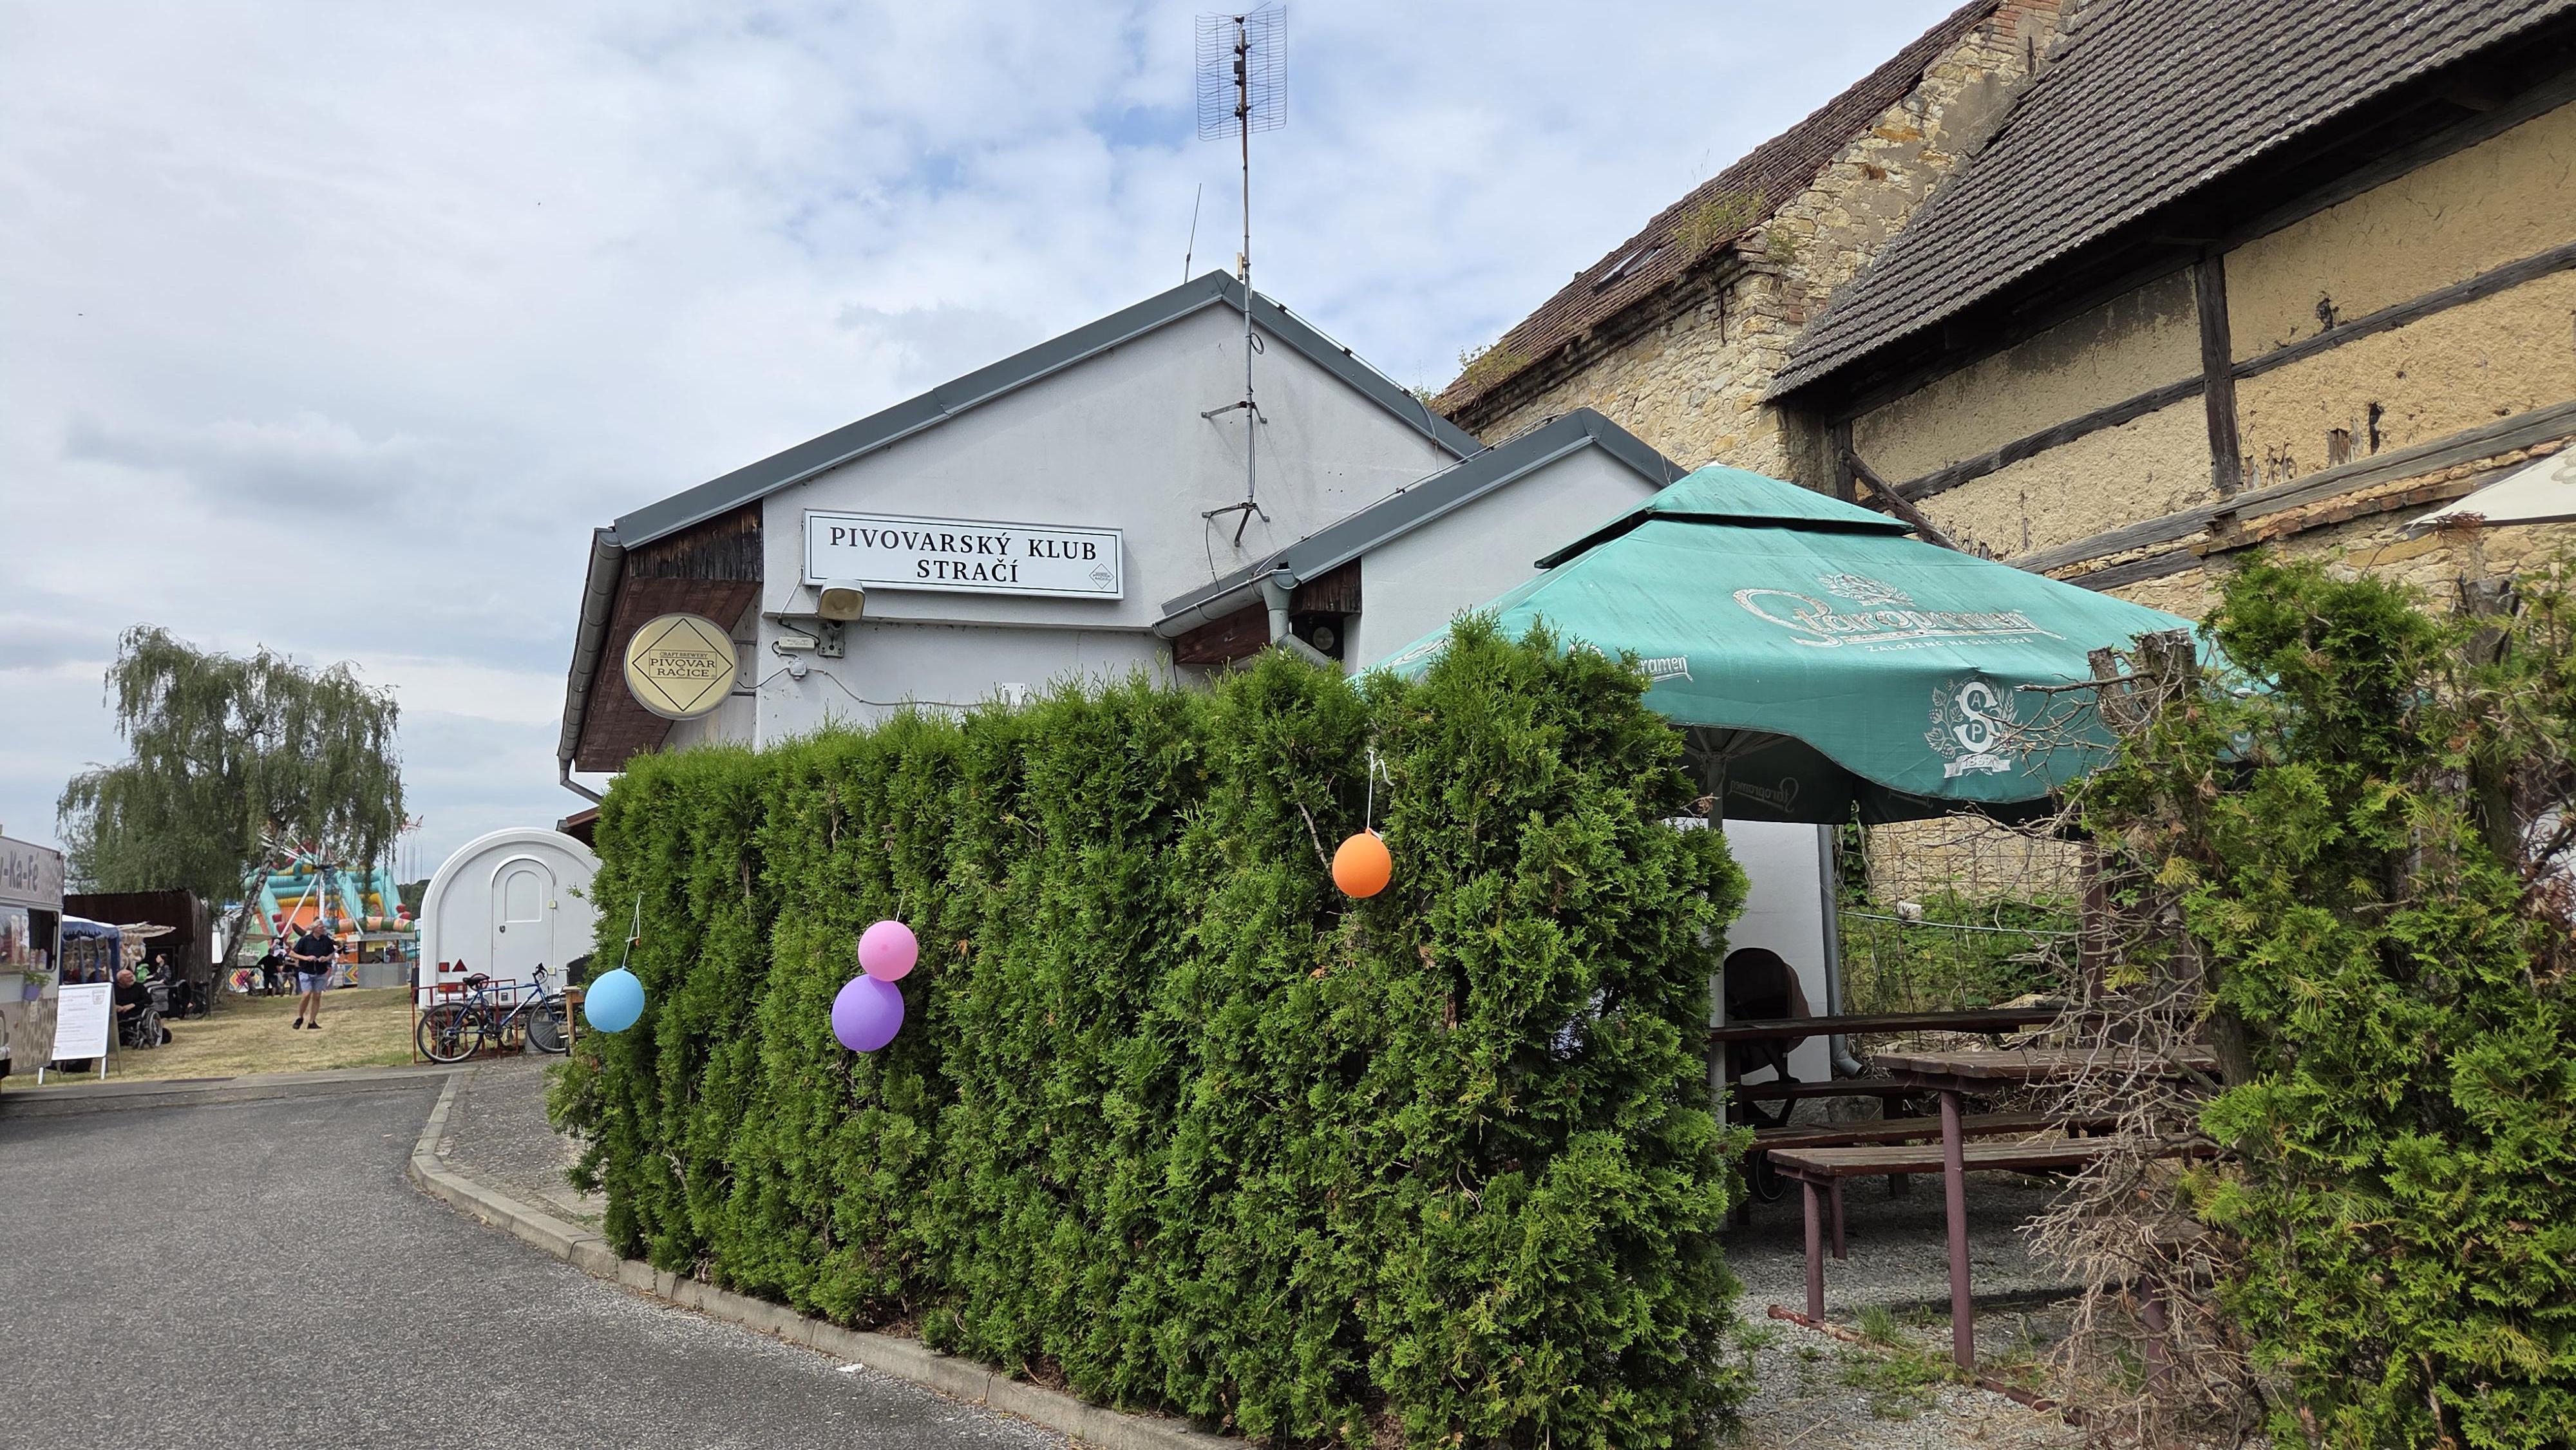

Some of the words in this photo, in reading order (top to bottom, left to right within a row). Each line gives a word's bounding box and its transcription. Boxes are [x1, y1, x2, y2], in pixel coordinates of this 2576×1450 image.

[830, 527, 1012, 556] PIVOVARSKÝ
[1028, 539, 1097, 560] KLUB
[918, 558, 1019, 583] STRAČÍ
[1732, 587, 2066, 648] Staropramen
[650, 658, 715, 668] PIVOVAR
[1964, 756, 1992, 767] 1869
